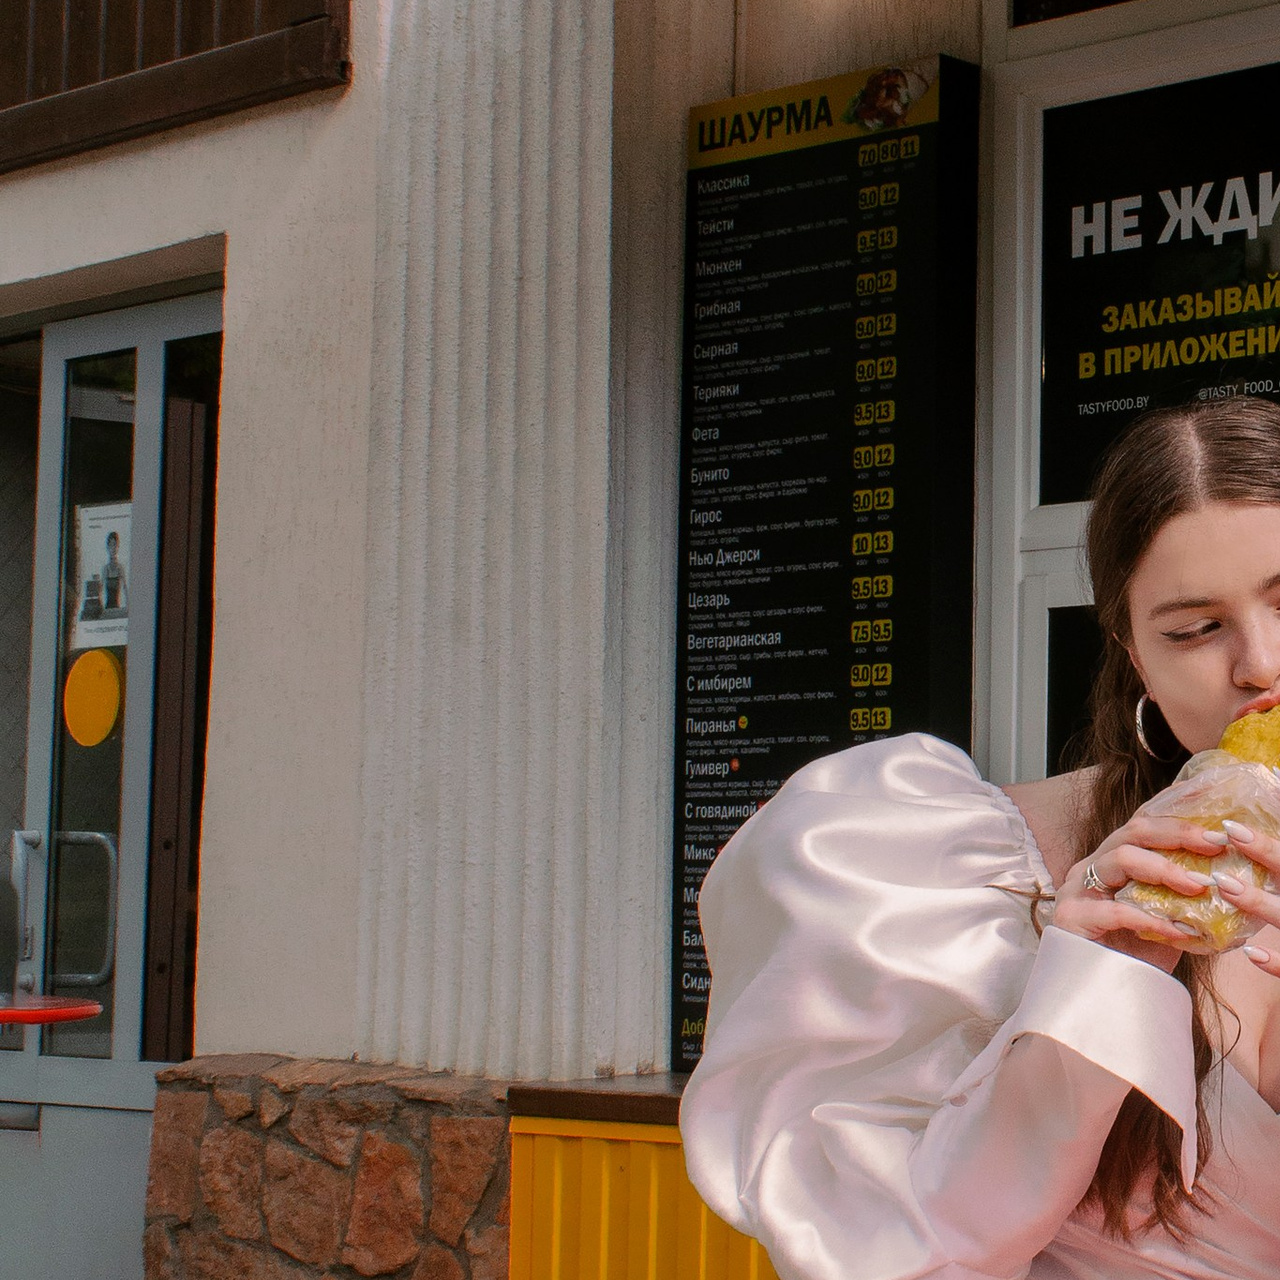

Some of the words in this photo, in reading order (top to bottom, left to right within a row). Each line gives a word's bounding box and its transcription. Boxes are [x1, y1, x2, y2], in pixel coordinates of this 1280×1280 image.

[698, 95, 834, 153] ШАУРМА
[1072, 195, 1142, 258] НЕ
[694, 341, 738, 360] Сырная
[1079, 352, 1096, 379] В
[693, 383, 739, 402] Терияки
[1078, 396, 1149, 416] TASTYFOOD.BY
[692, 425, 719, 441] Фета
[690, 509, 722, 528] Гирос
[875, 534, 888, 550] 13
[689, 550, 714, 566] Нью
[716, 547, 761, 566] Джерси
[874, 578, 888, 595] 13
[687, 591, 730, 609] Цезарь
[687, 631, 782, 651] Вегетарианская
[874, 665, 888, 681] 12
[687, 676, 695, 692] С
[697, 674, 752, 693] имбирем
[685, 718, 736, 736] Пиранья
[873, 710, 887, 727] 13
[685, 760, 729, 779] Гуливер
[685, 802, 694, 819] С
[695, 801, 757, 820] говядиной
[684, 844, 716, 860] Микс
